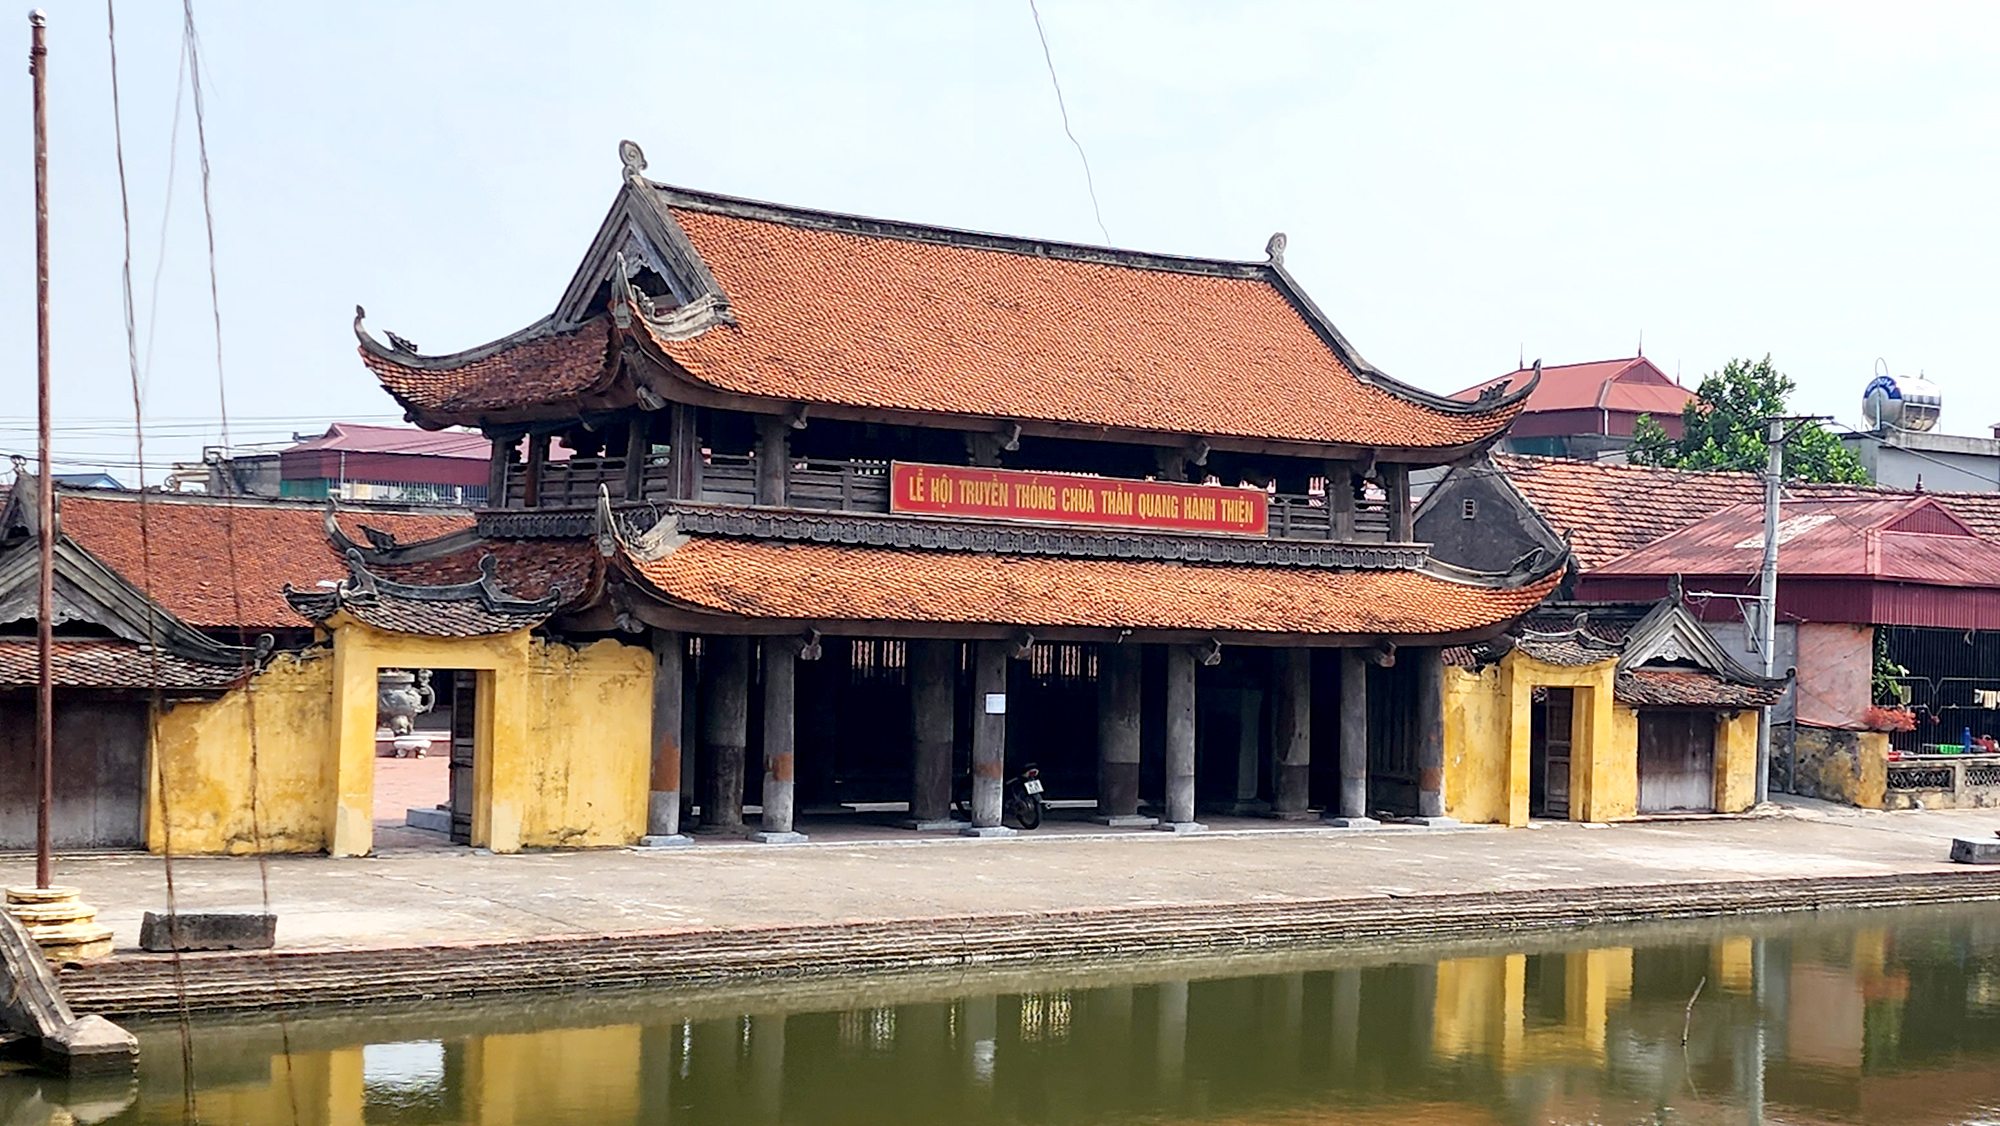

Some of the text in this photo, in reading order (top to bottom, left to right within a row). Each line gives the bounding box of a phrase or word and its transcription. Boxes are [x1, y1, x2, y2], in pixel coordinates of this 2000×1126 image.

[931, 473, 953, 508] HỘI
[959, 474, 1009, 507] TRUYỀN
[1015, 477, 1056, 511] THỐNG
[1062, 484, 1095, 513] CHÙA
[1101, 484, 1133, 516] THẦN
[1138, 493, 1179, 519] QUANG
[1184, 492, 1216, 521] HÀNH
[1221, 495, 1254, 527] THIỆN
